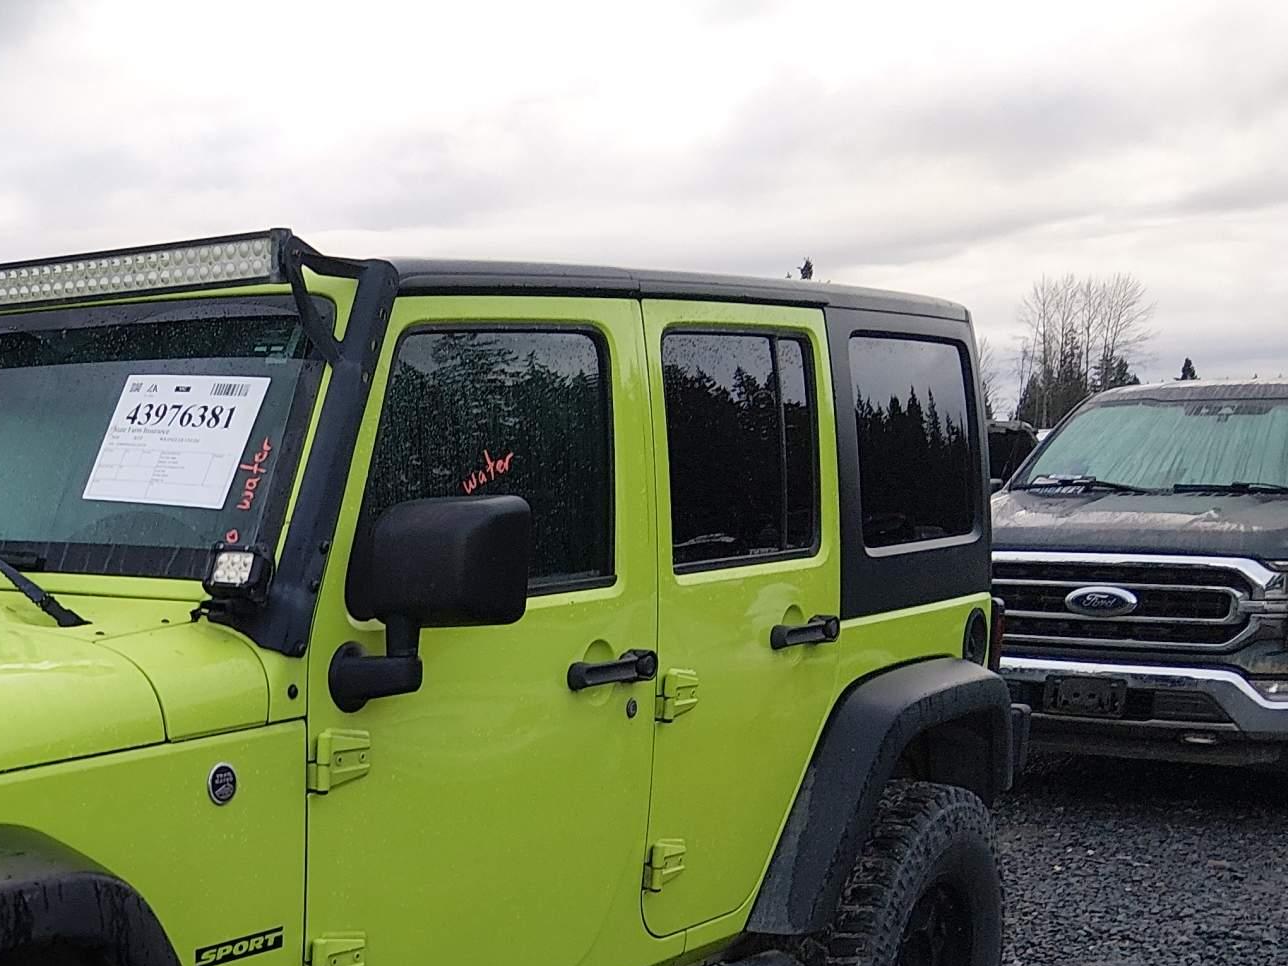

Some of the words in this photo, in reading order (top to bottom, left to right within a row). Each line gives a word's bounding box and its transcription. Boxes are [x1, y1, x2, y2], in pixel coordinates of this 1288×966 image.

[126, 403, 236, 429] 43976381
[462, 449, 514, 494] water
[1082, 593, 1116, 607] Ford
[200, 932, 283, 964] SPORT
